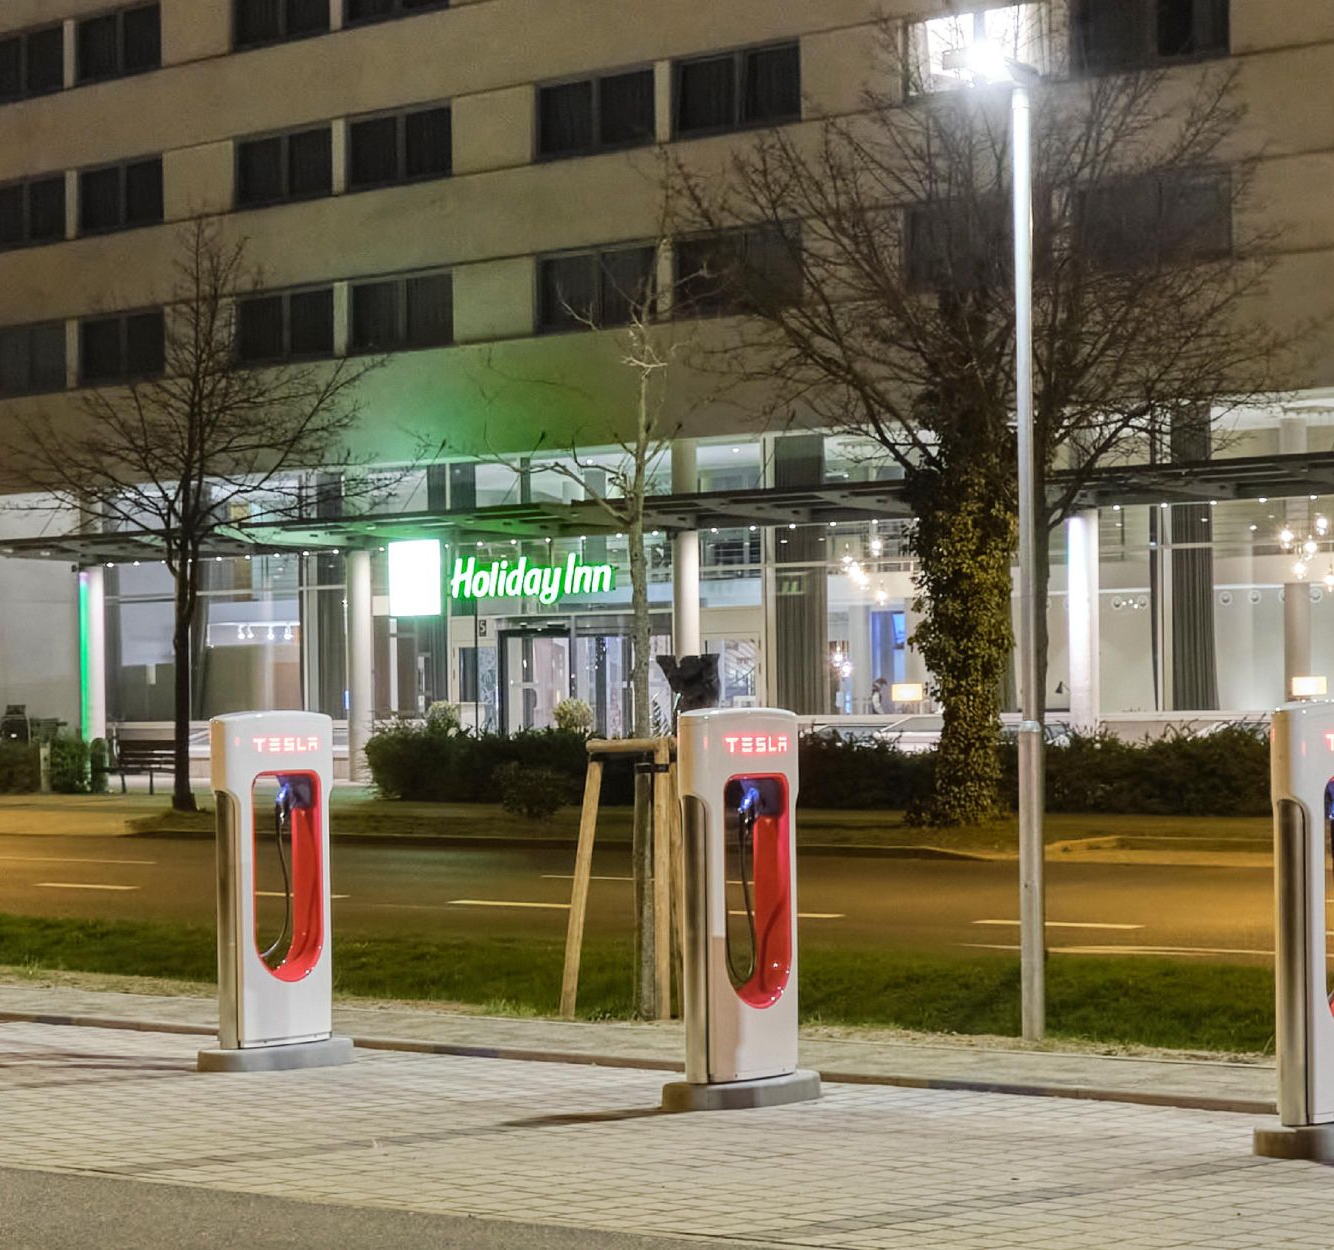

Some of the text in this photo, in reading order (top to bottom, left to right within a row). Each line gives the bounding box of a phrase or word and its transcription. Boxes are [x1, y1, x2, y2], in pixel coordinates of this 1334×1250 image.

[451, 553, 612, 604] Holiday Inn
[252, 737, 318, 752] TESLA
[725, 736, 787, 753] TESLA
